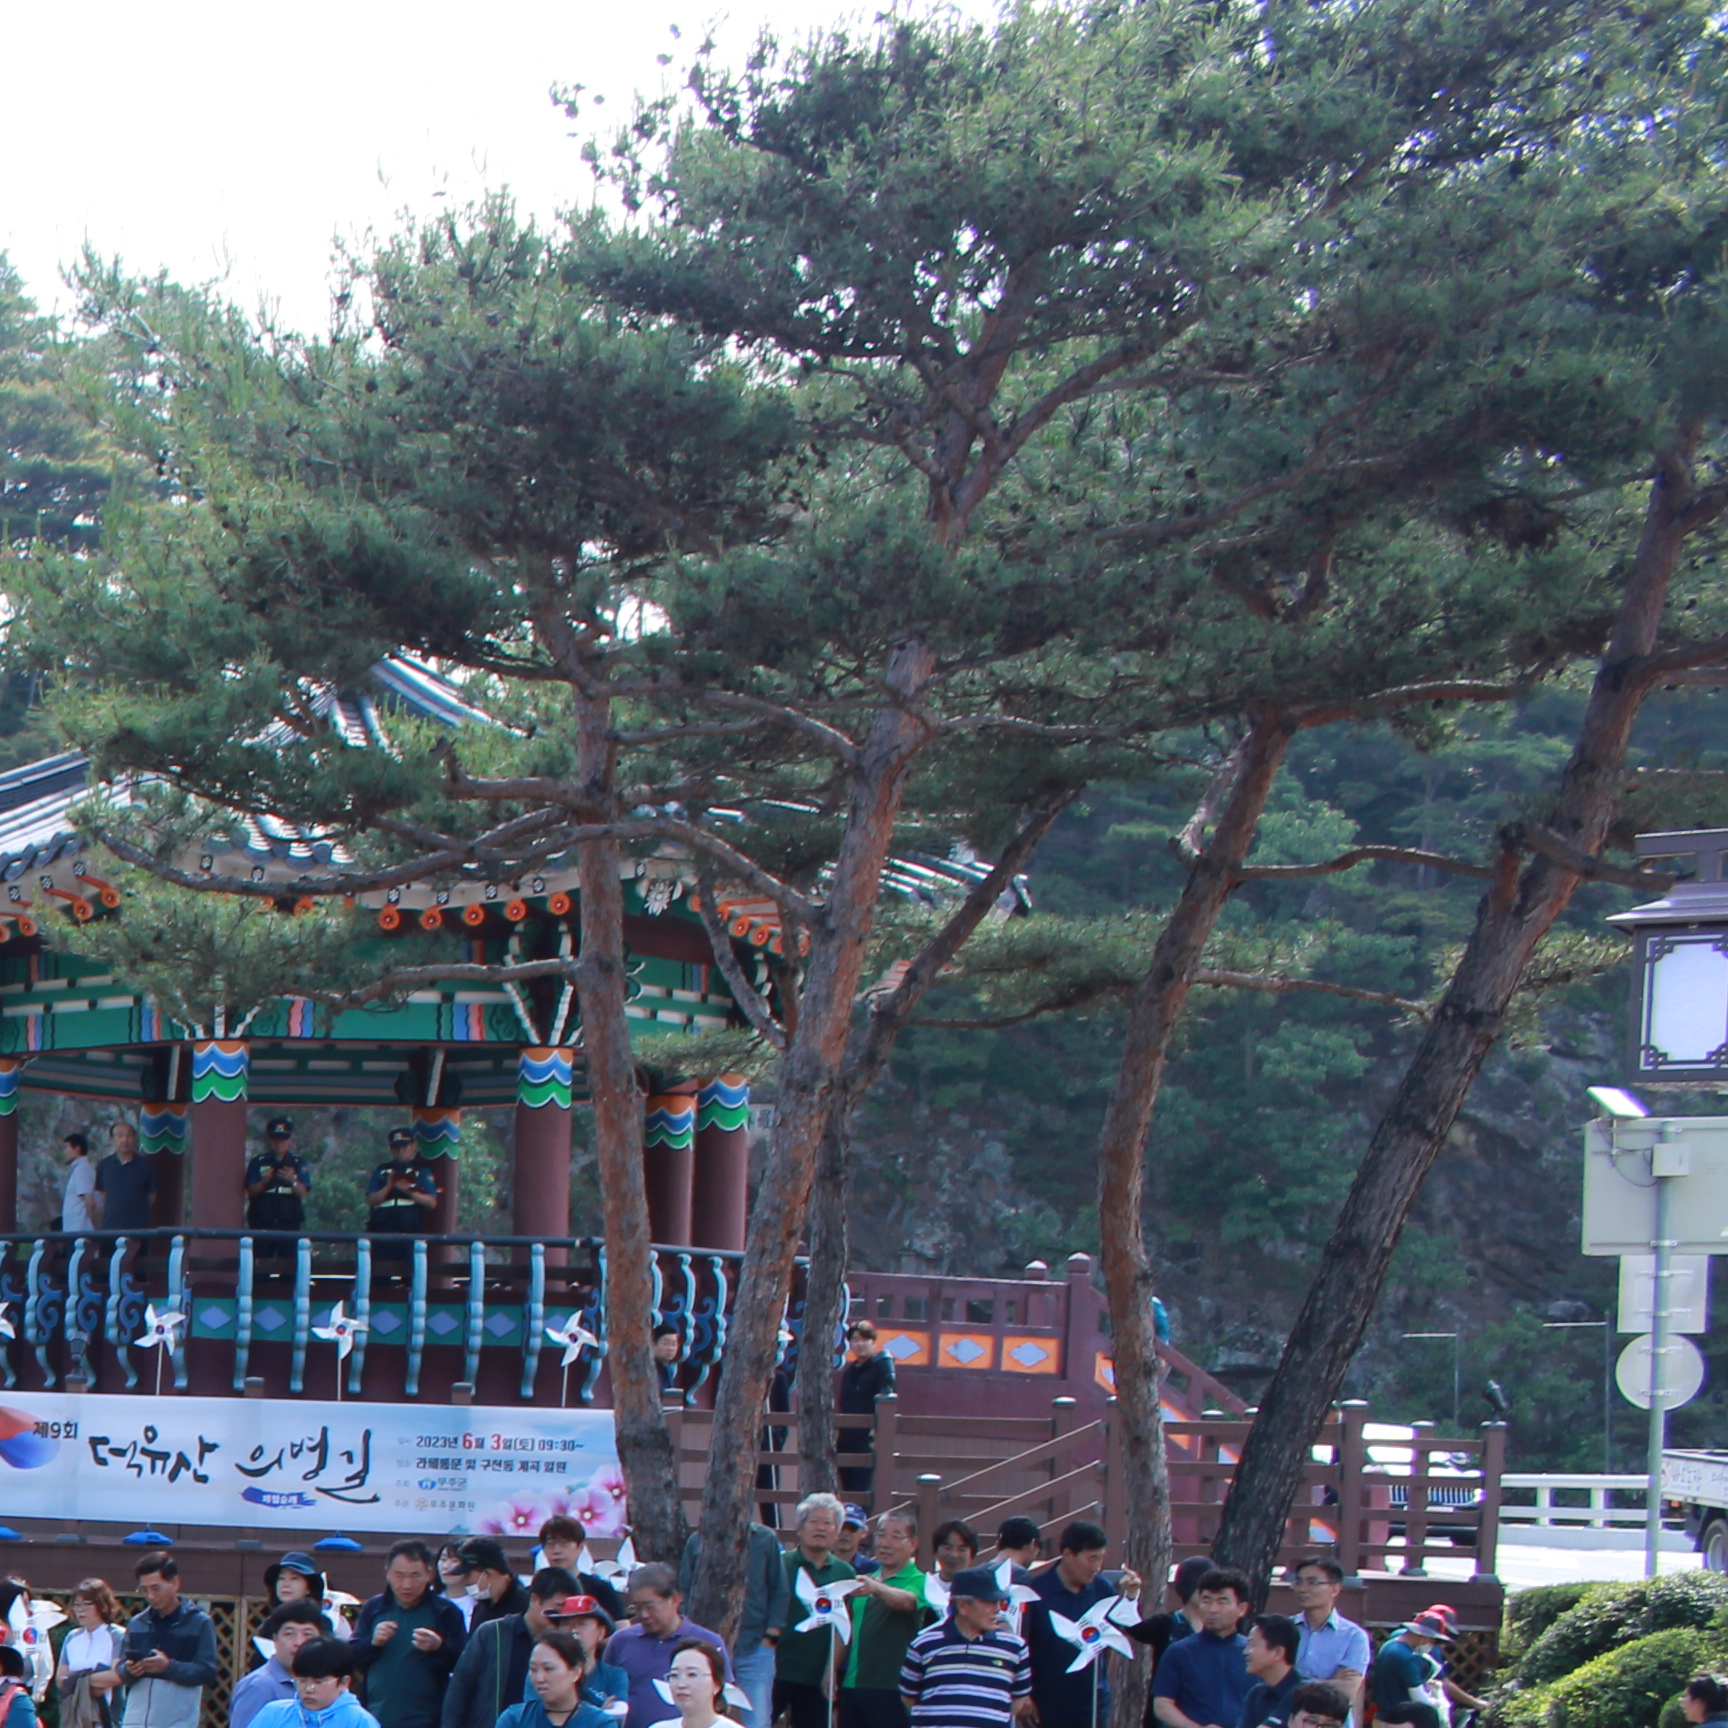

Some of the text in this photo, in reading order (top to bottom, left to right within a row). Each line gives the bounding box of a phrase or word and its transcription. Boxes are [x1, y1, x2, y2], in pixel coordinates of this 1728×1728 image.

[32, 1421, 78, 1441] 제9회
[416, 1435, 458, 1449] 2023년
[462, 1432, 485, 1450] 6월
[490, 1433, 535, 1451] 3일(토)
[88, 1425, 381, 1504] 덕유산 의병길
[465, 1458, 477, 1471] 및
[480, 1459, 514, 1472] 구천동
[517, 1460, 541, 1473] 계곡
[543, 1461, 567, 1474] 일원
